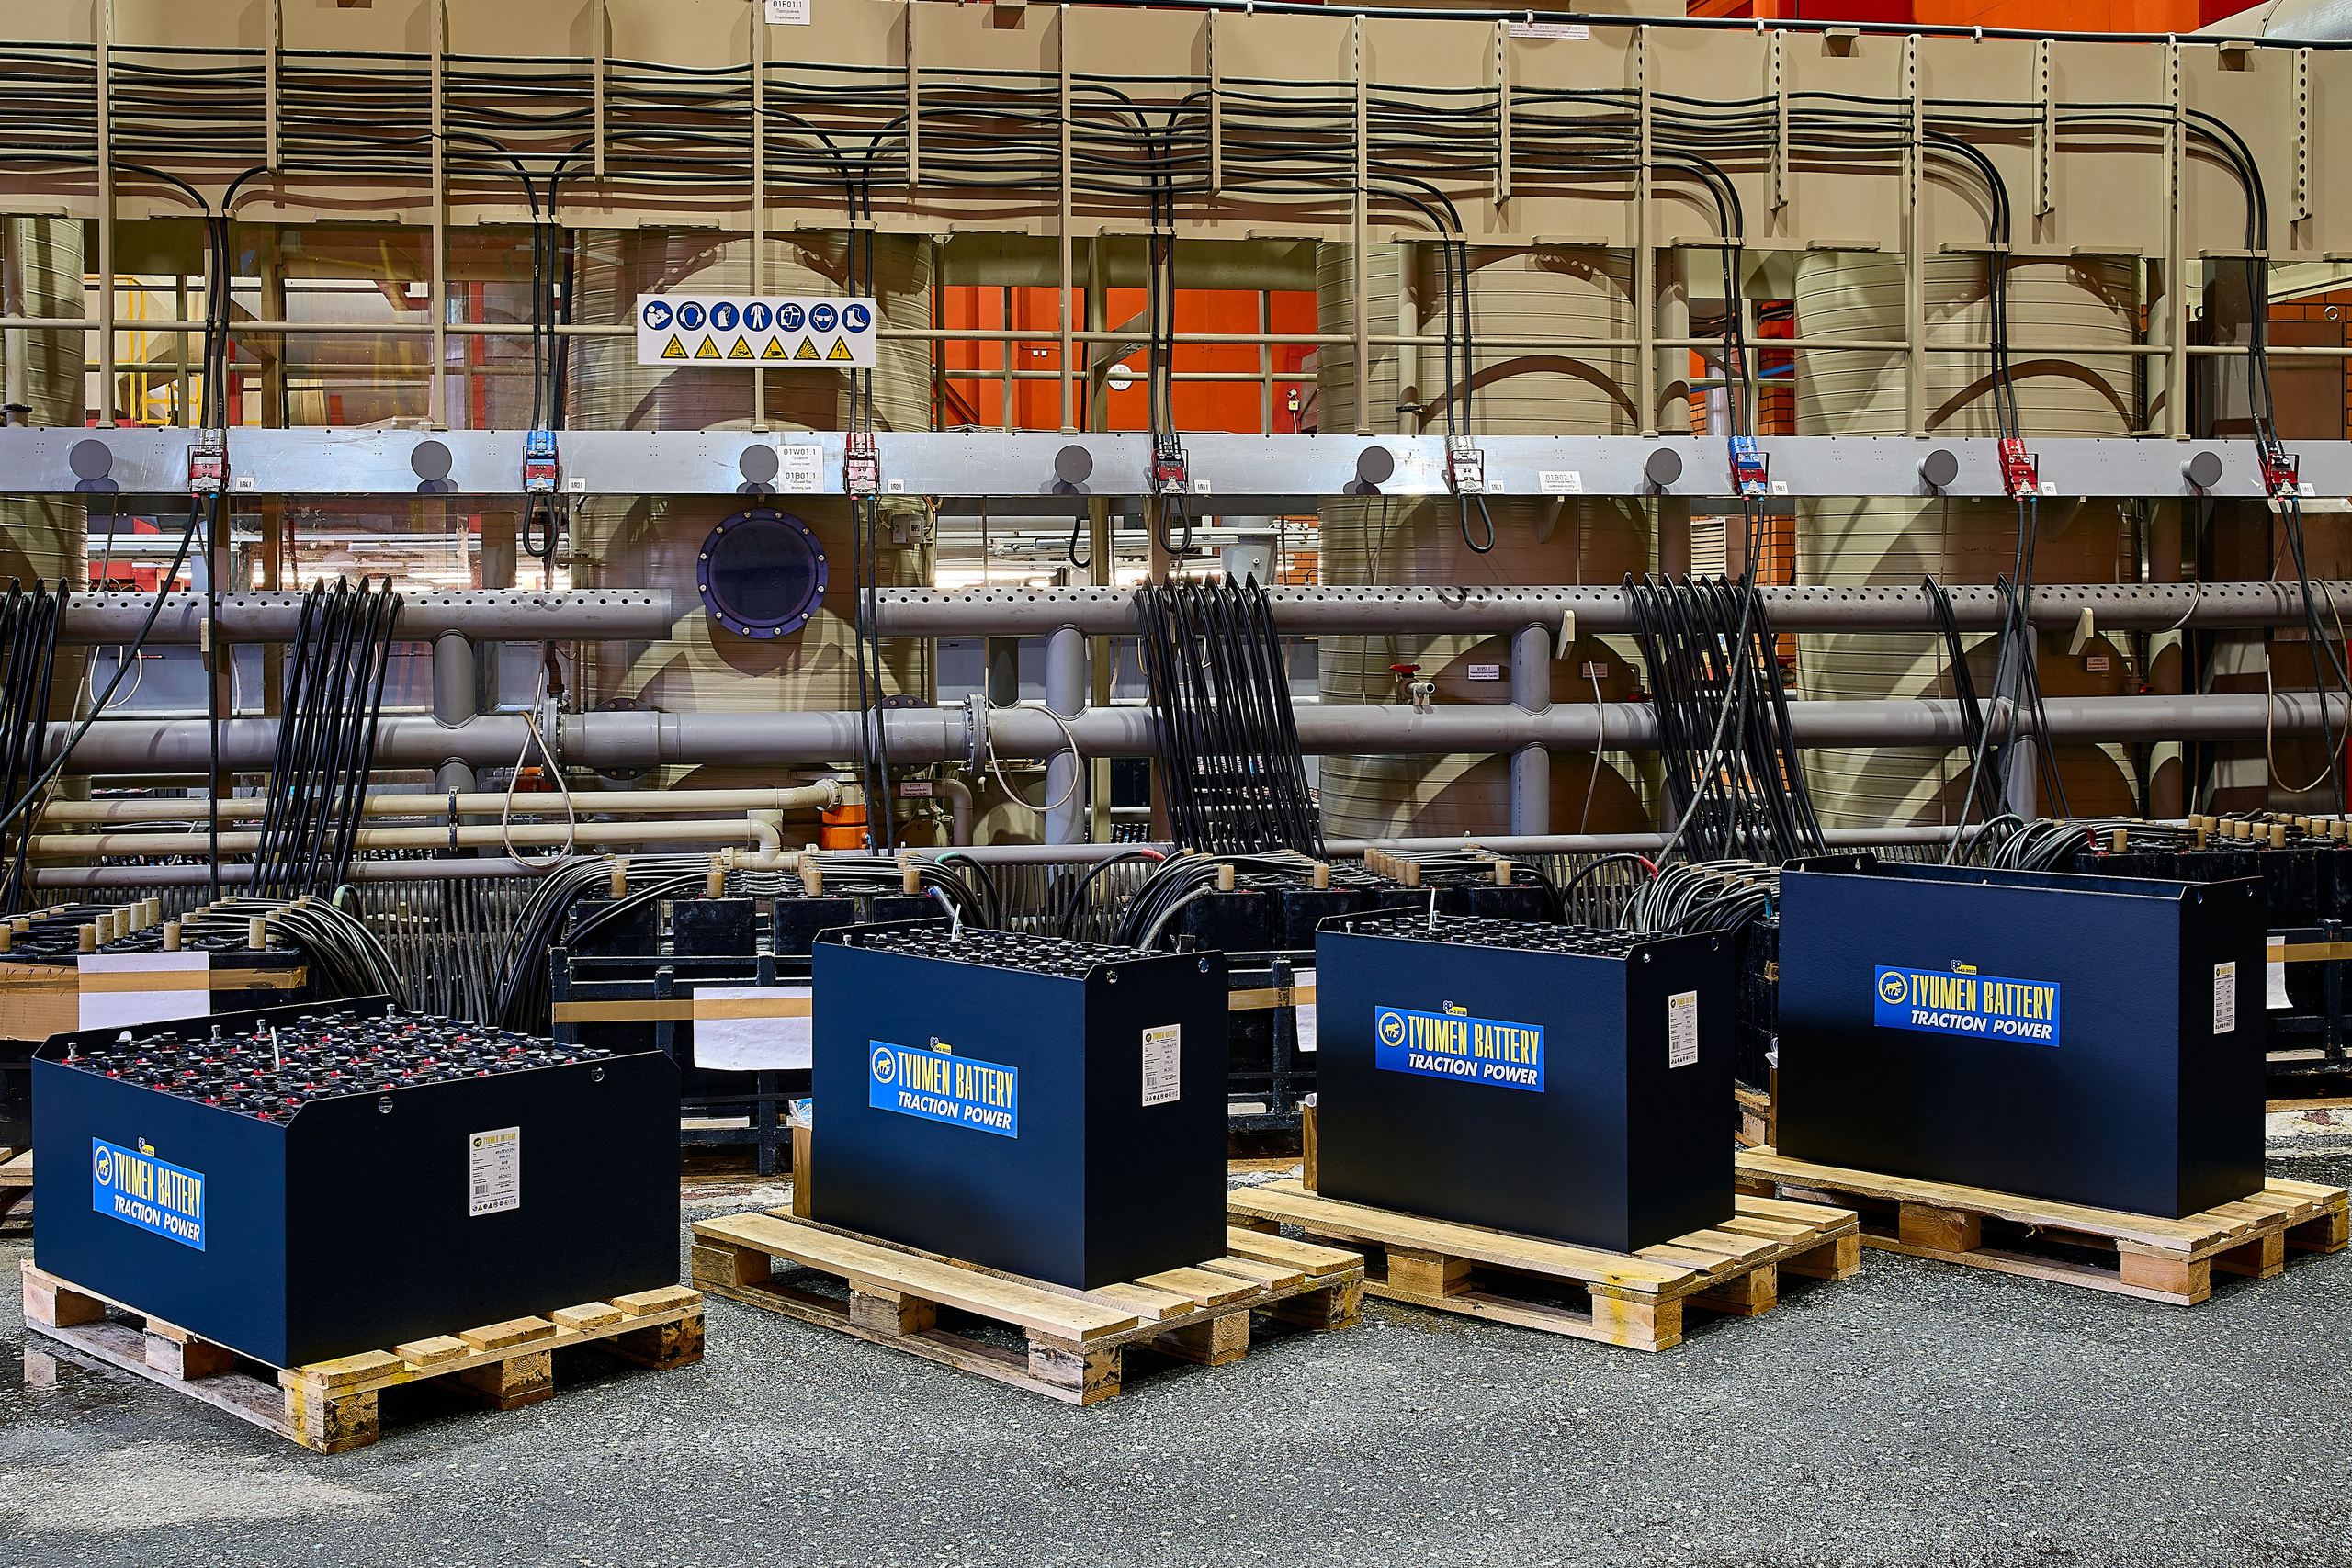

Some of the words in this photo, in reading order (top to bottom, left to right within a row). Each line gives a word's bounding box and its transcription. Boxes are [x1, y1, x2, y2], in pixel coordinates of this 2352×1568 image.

[773, 0, 802, 8] 01F01.1
[1910, 975, 1976, 1012] TYUMEN
[1984, 982, 2055, 1021] BATTERY
[1407, 1015, 1468, 1055] TYUMEN
[1475, 1023, 1540, 1066] BATTERY
[1910, 1010, 1987, 1032] TRACTION
[1992, 1020, 2052, 1040] POWER
[897, 1051, 951, 1097] TYUMEN
[956, 1063, 1014, 1109] BATTERY
[1408, 1053, 1478, 1077] TRACTION
[1483, 1064, 1538, 1086] POWER
[898, 1091, 959, 1118] TRACTION
[964, 1105, 1012, 1130] POWER
[113, 1151, 154, 1202] TYUMEN
[157, 1166, 202, 1219] BATTERY
[114, 1194, 161, 1227] TRACTION
[164, 1213, 200, 1242] POWER
